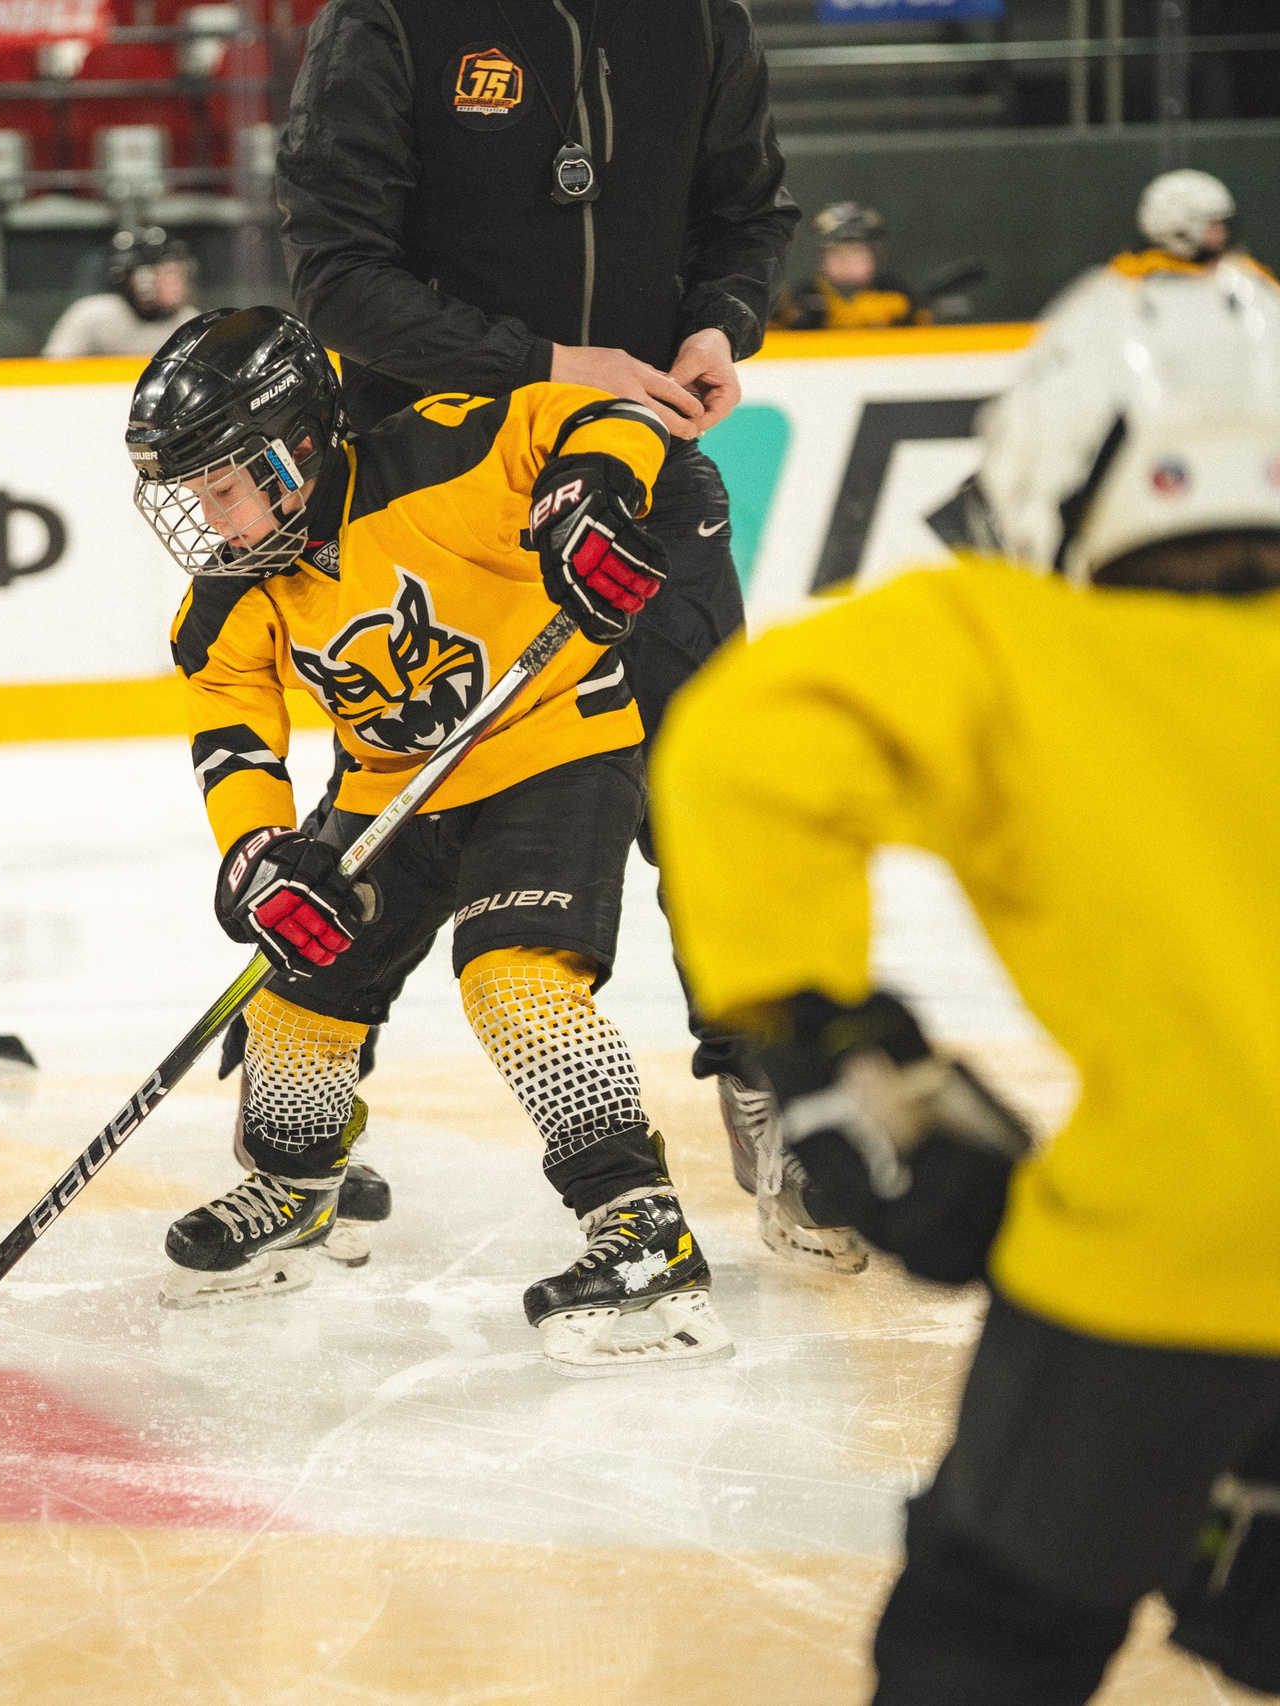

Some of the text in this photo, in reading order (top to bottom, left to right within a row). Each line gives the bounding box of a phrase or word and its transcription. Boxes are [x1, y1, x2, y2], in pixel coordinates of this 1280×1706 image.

[250, 373, 299, 411] BAUER
[454, 890, 573, 931] BAUER
[29, 1069, 169, 1238] BAUER
